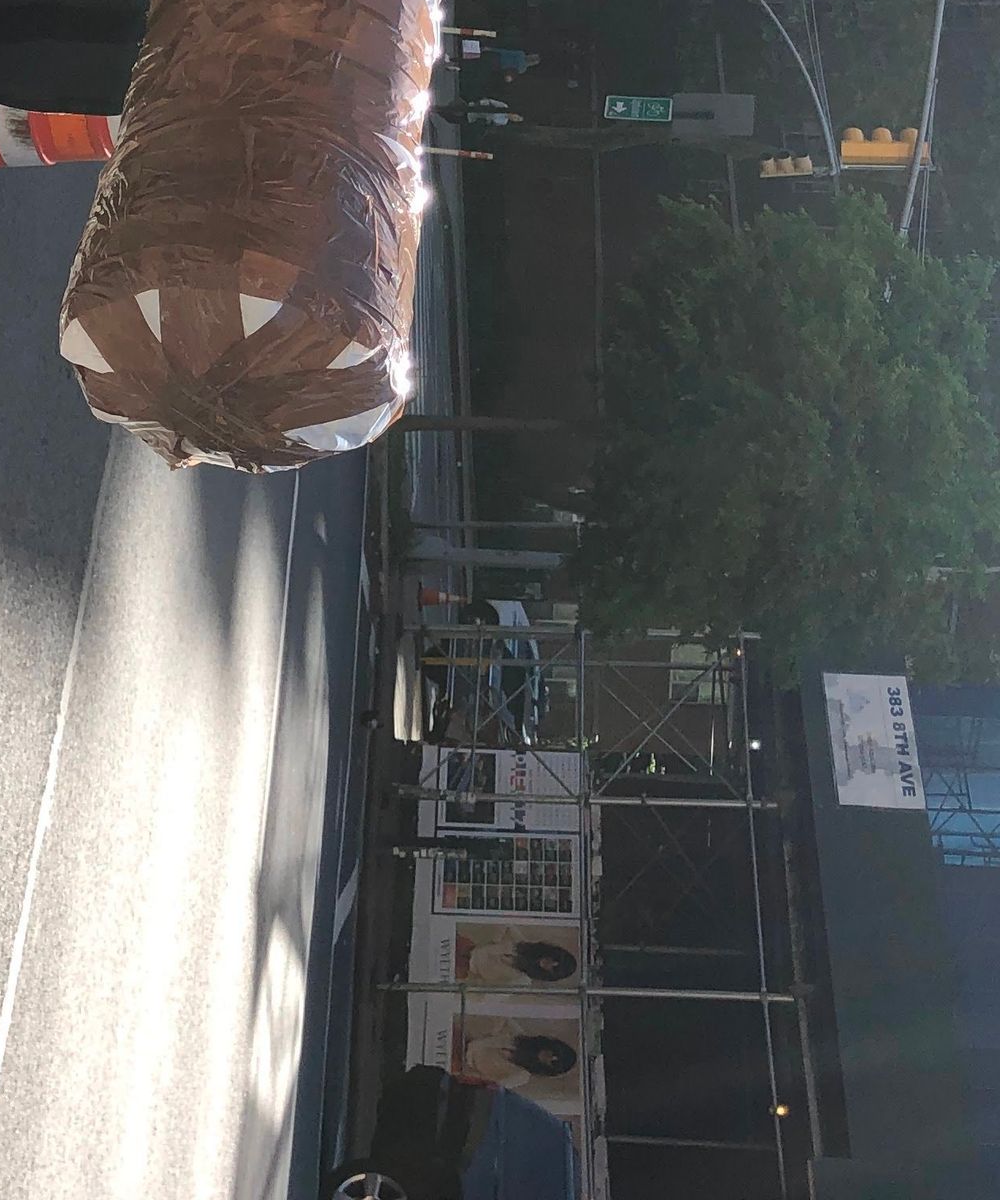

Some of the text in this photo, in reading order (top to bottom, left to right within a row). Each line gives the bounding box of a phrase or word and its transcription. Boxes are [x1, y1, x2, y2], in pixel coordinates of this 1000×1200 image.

[887, 686, 916, 796] 383 8TH AVE
